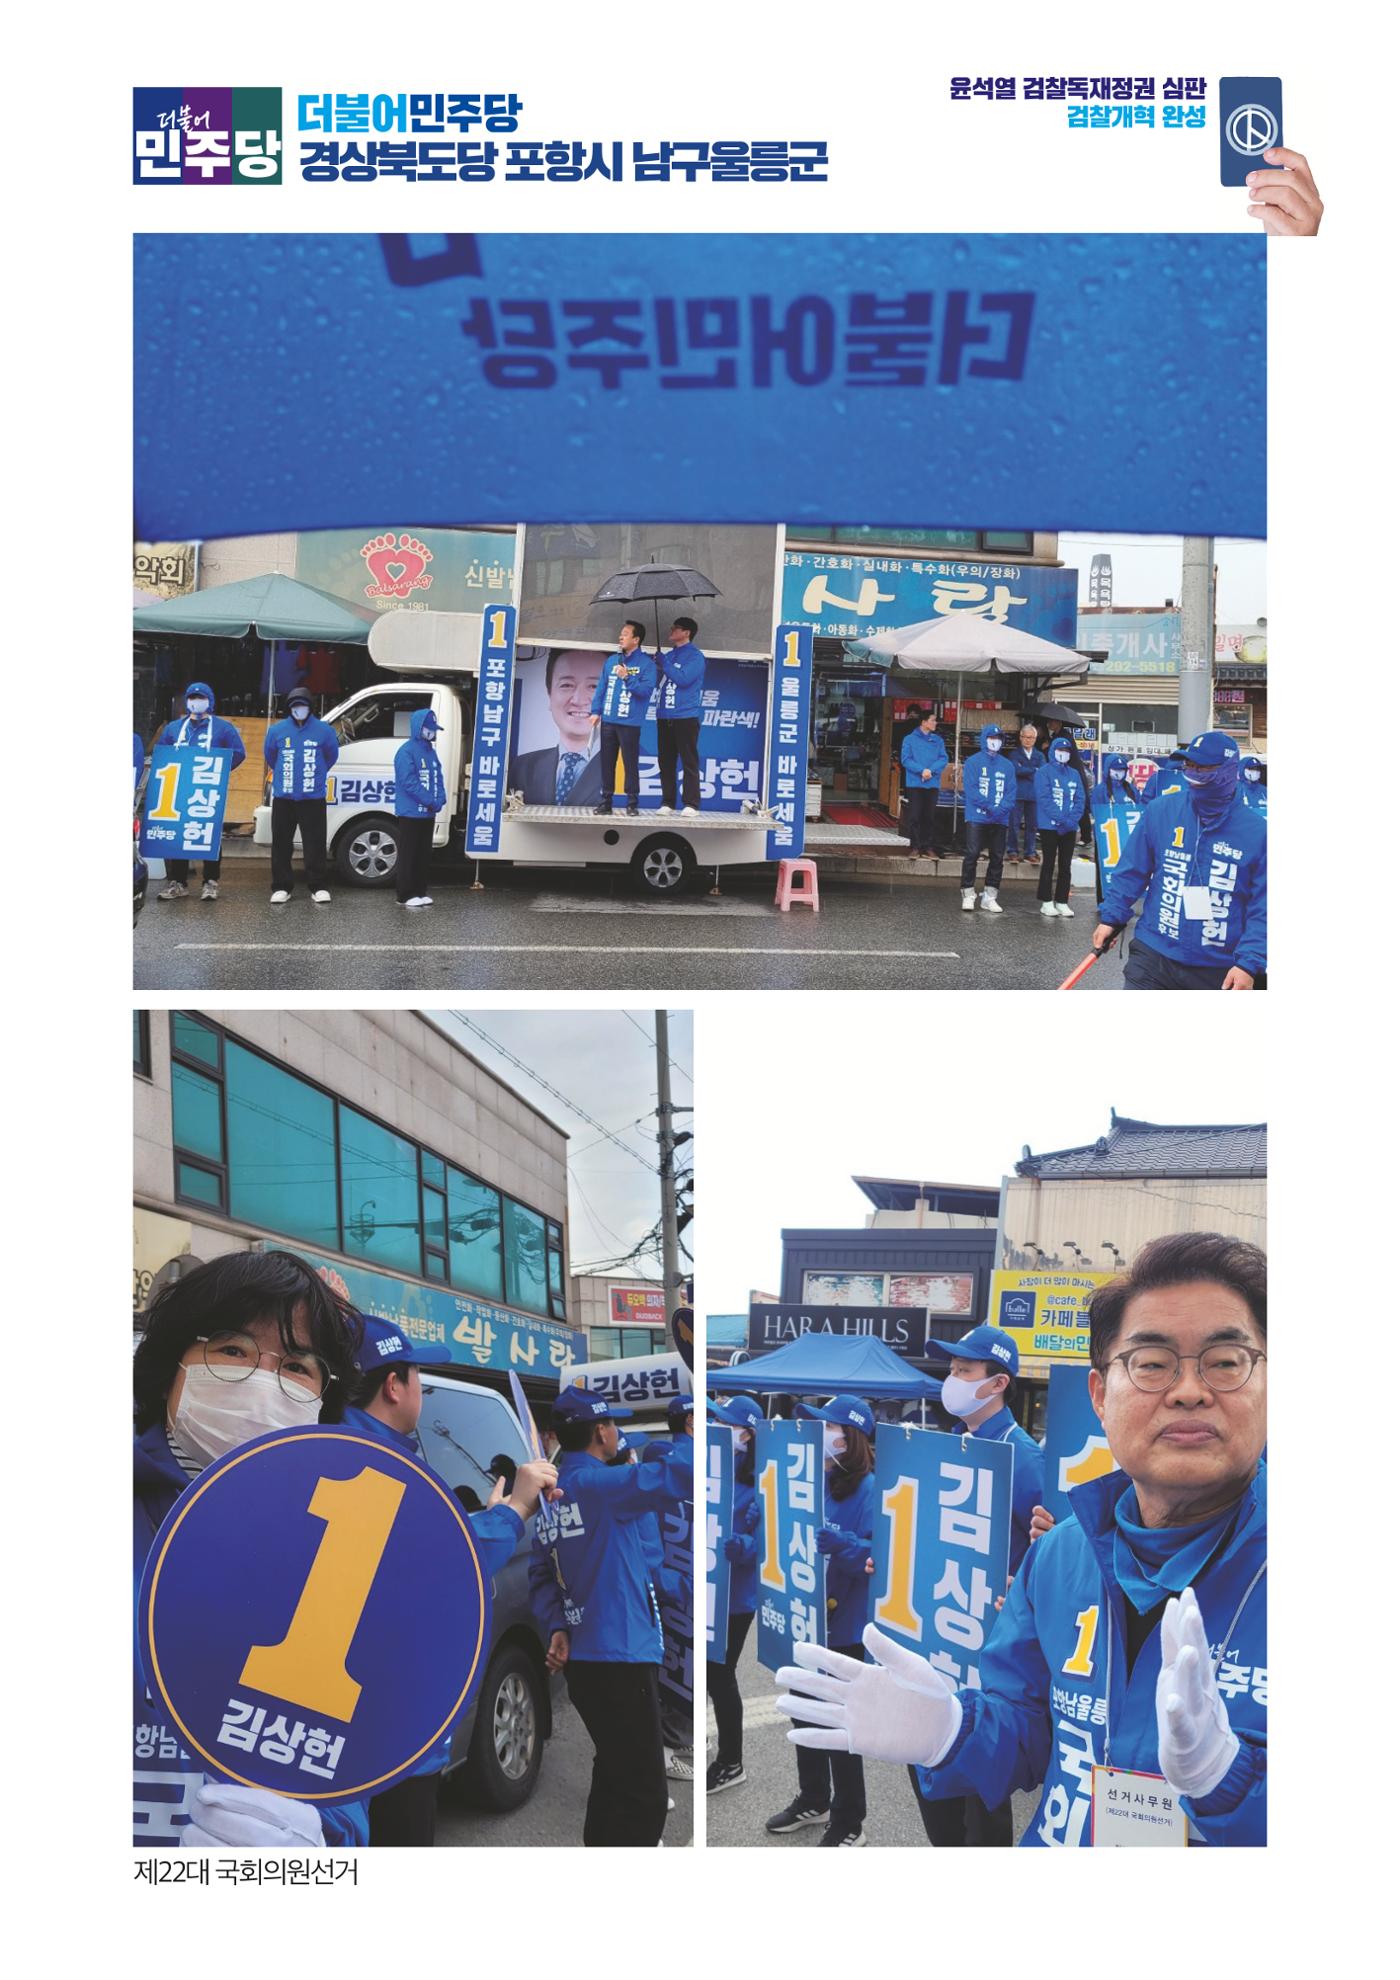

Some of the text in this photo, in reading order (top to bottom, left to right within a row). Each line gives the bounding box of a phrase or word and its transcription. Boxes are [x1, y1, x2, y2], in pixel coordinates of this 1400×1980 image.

[376, 600, 404, 611] Since
[489, 610, 507, 649] 1
[783, 630, 801, 668] 1
[701, 709, 760, 729] 파란색!
[147, 762, 182, 822] 1
[182, 755, 224, 852] 김상헌
[473, 756, 501, 847] 바로세움
[1100, 818, 1121, 868] 1
[1171, 826, 1185, 849] 1
[376, 1336, 403, 1356] 김상헌
[593, 1367, 681, 1403] 김상헌
[758, 1458, 787, 1594] 1
[874, 1475, 923, 1643] 1
[238, 1465, 408, 1724] 1
[1061, 1604, 1100, 1678] 1
[216, 1697, 347, 1781] 김상헌
